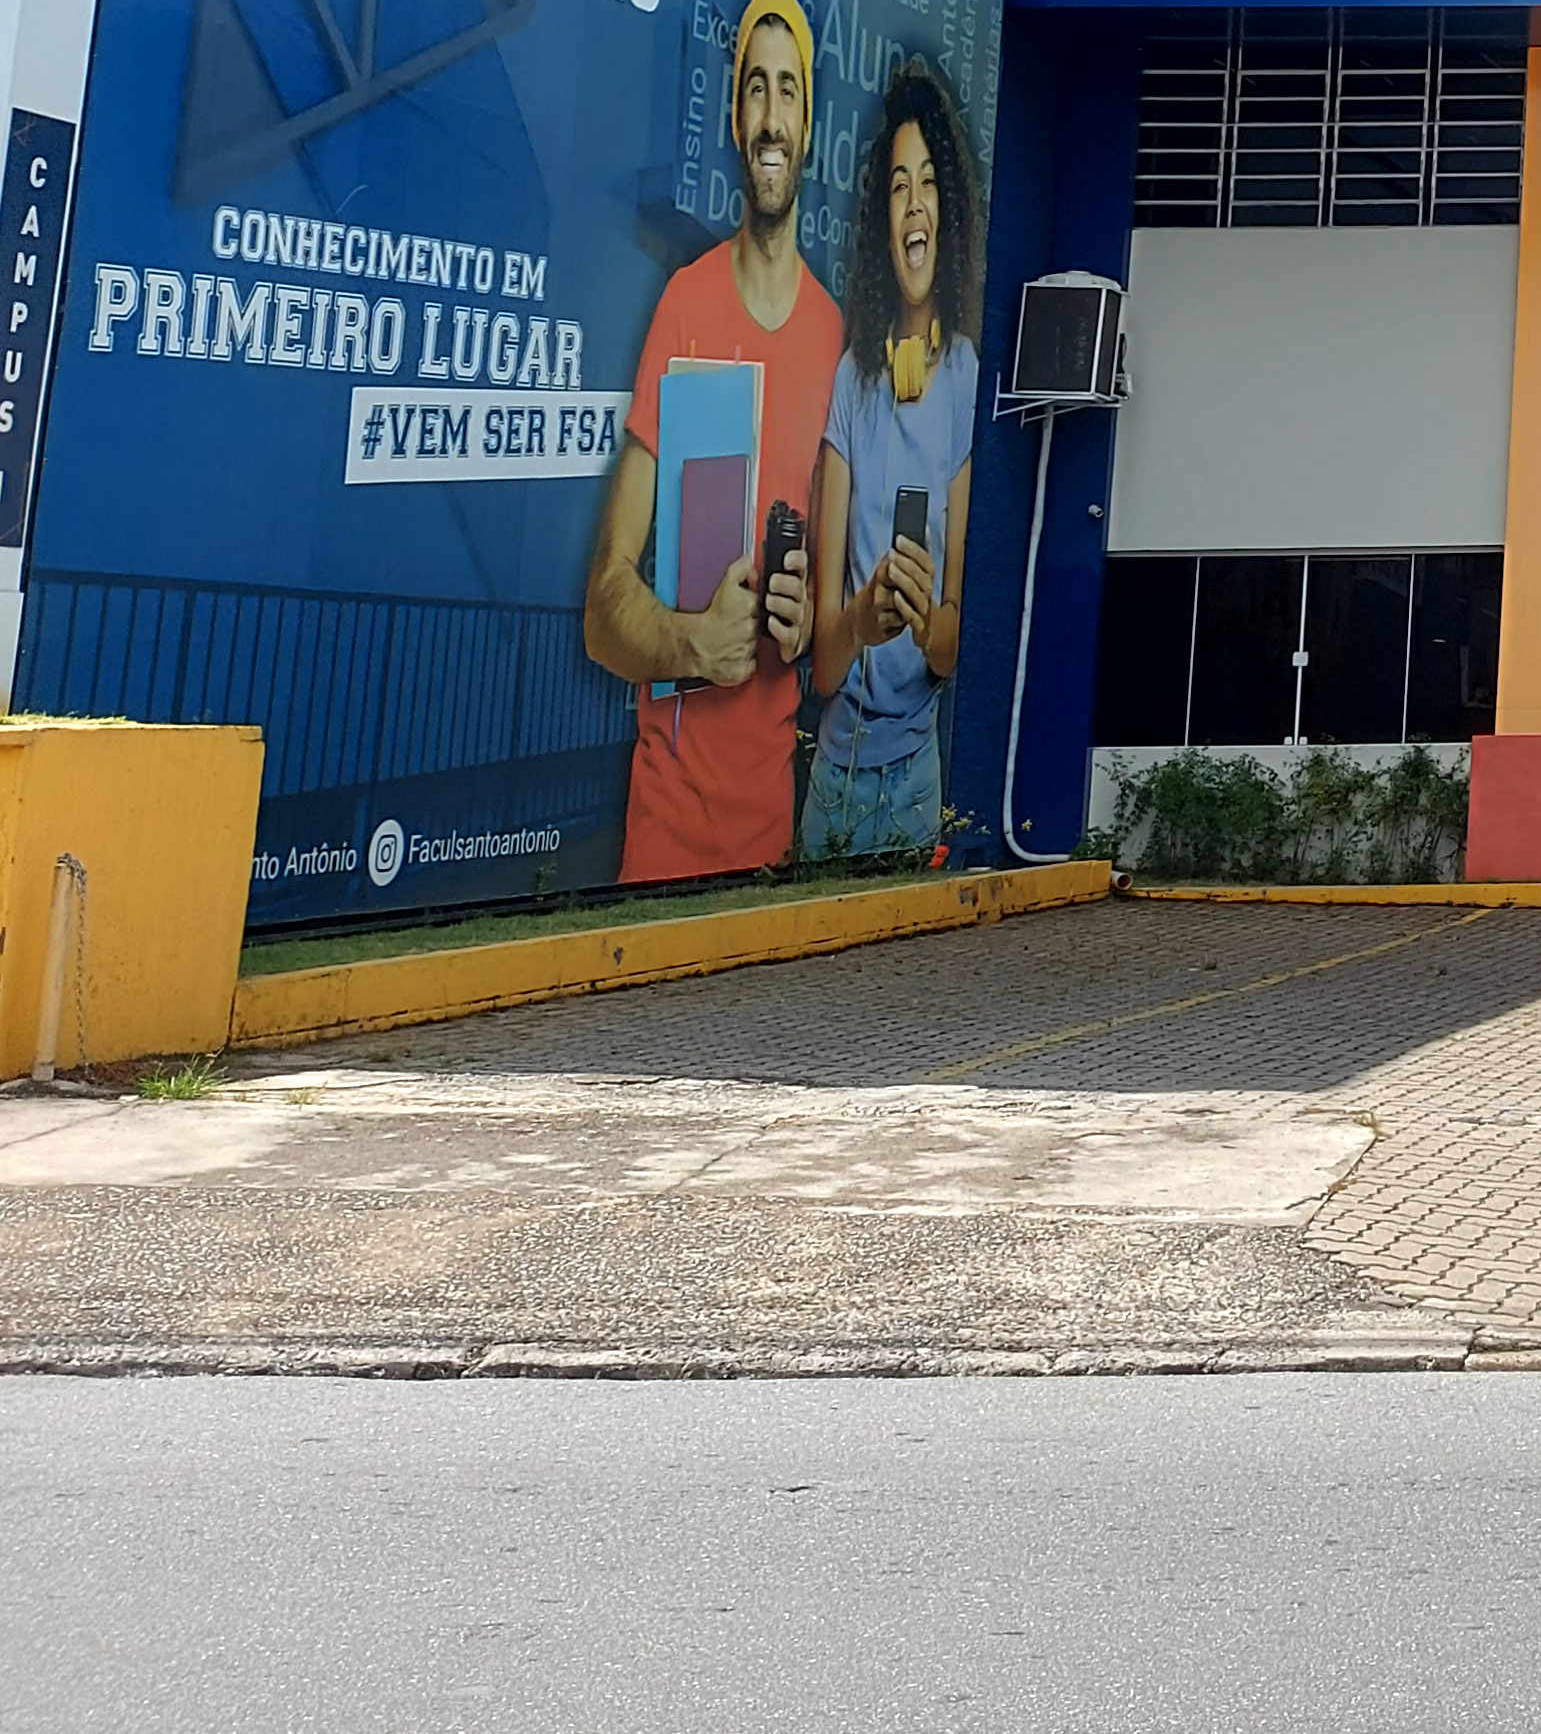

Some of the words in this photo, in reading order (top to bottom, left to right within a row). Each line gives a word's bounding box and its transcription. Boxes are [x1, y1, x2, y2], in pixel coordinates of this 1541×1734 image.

[675, 66, 707, 215] Ensino
[212, 205, 494, 294] CONHECIMENTO
[502, 253, 548, 302] EM
[88, 263, 405, 376] PRIMEIRO
[417, 302, 584, 391] LUGAR
[361, 404, 471, 461] #VEM
[482, 405, 547, 457] SER
[556, 408, 619, 458] FSA
[283, 841, 358, 878] Antônio
[407, 823, 561, 865] Faculsantoantonio
